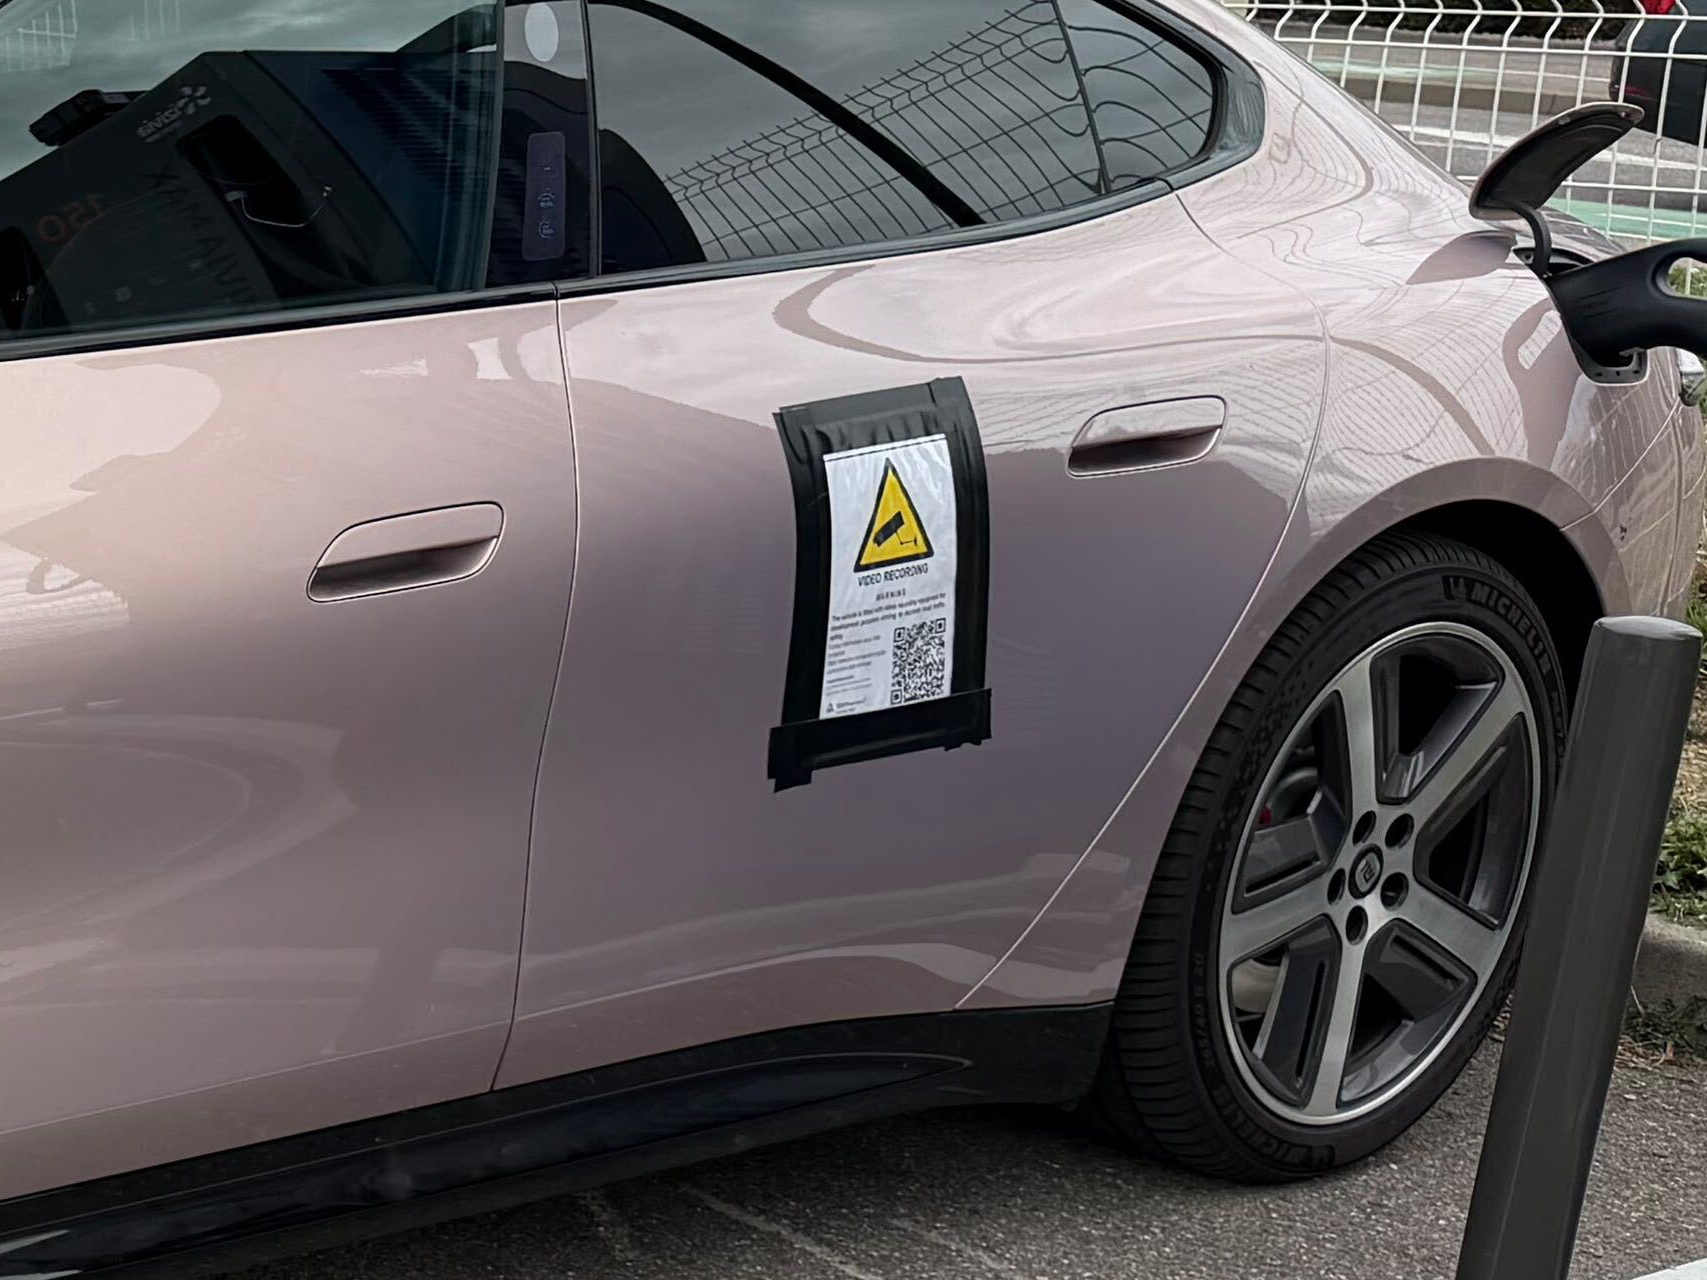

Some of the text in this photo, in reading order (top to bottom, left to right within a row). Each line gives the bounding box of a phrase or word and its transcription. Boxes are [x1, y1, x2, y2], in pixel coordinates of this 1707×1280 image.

[857, 562, 929, 587] VIDEO RECORDING
[1471, 581, 1552, 676] MICHELIN
